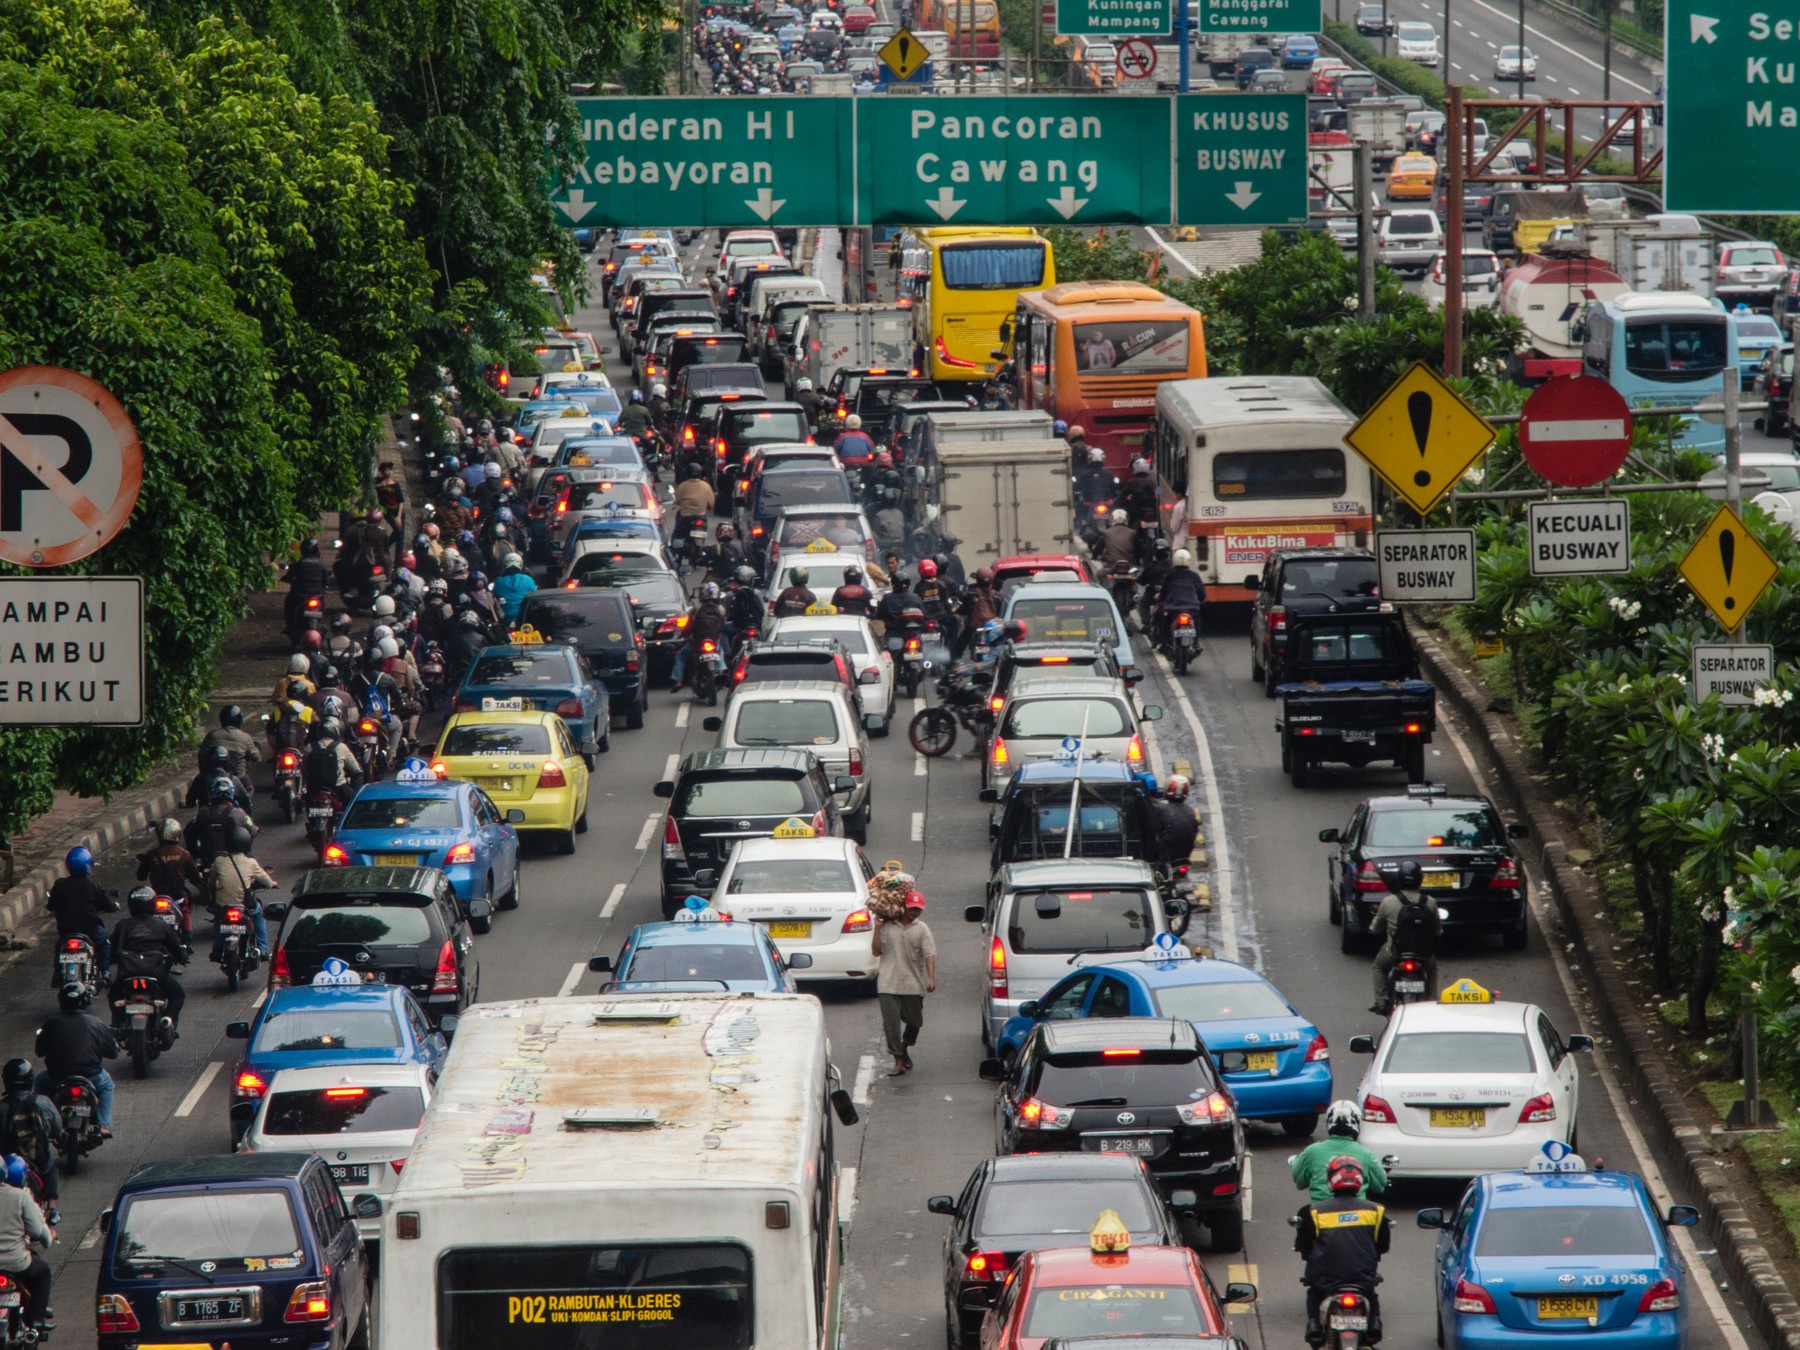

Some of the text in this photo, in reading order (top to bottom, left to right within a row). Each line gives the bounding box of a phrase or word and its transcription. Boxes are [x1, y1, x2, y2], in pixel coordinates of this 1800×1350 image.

[1088, 15, 1160, 28] Mampang
[1209, 14, 1269, 28] Cawang
[1748, 13, 1800, 40] Se
[1747, 57, 1795, 83] Ku
[1193, 111, 1290, 131] KHUSUS
[1747, 101, 1798, 127] Ma
[546, 112, 722, 141] underan
[911, 110, 1102, 139] Pancoran
[1197, 149, 1286, 170] BUSWAY
[568, 156, 773, 191] Kebayoran
[916, 153, 1098, 192] Cawang
[1537, 514, 1622, 533] KECUALI
[1227, 535, 1306, 549] KukuBima
[1384, 544, 1467, 562] SEPARATOR
[1538, 541, 1620, 560] BUSWAY
[1397, 571, 1455, 588] BUSWAY
[0, 642, 105, 663] AMBU
[1700, 656, 1766, 672] SEPARATOR
[495, 700, 522, 710] TAKSI
[509, 762, 520, 770] DC
[780, 828, 808, 837] TAKSI
[1450, 993, 1483, 1001] TAKSI
[1101, 1138, 1151, 1151] B 219 RK
[331, 1166, 368, 1177] 98 TIE
[1537, 1163, 1576, 1171] TAKSI
[1093, 1233, 1130, 1245] TAKSI
[1583, 1273, 1648, 1286] XD 4958
[179, 1300, 242, 1316] B 1765 ZF
[509, 1296, 547, 1323] P02
[1539, 1298, 1546, 1311] B
